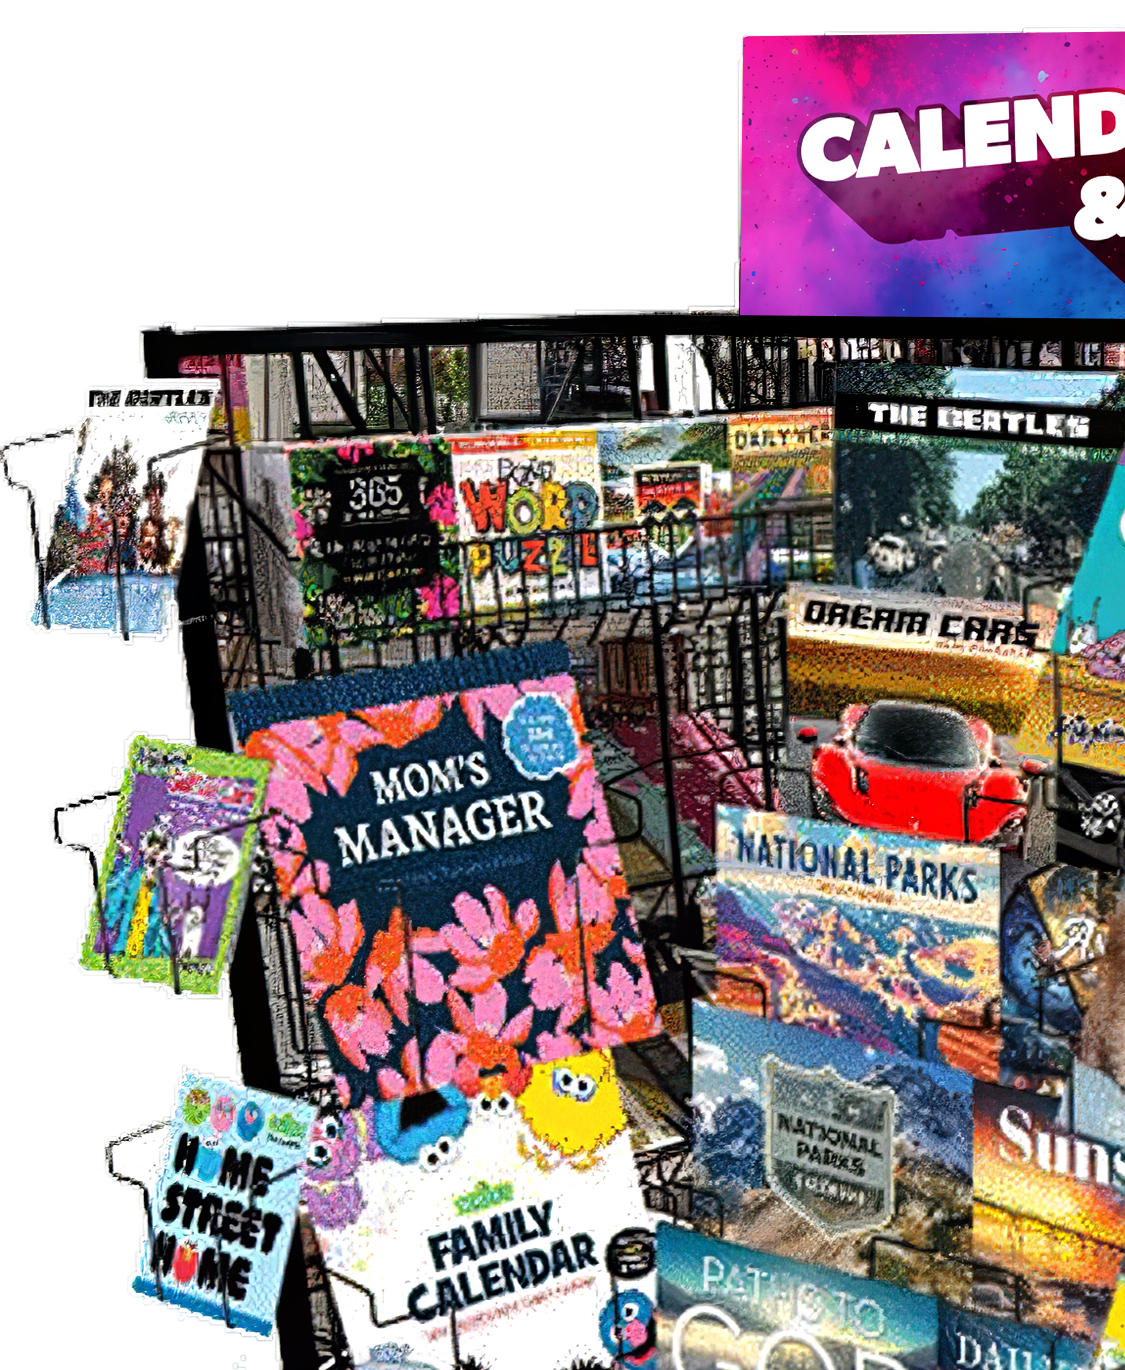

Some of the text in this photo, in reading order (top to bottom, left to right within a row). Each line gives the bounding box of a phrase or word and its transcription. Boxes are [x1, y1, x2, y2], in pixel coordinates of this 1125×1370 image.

[867, 401, 1091, 440] THE BEATLES
[459, 477, 600, 534] WORD
[803, 600, 931, 634] DREAM
[939, 614, 1040, 647] CARS
[369, 750, 492, 805] MOM'S
[333, 790, 553, 868] MANAGER
[735, 828, 979, 905] NATIONAL PARKS
[776, 1111, 883, 1159] NATIONAL
[159, 1181, 284, 1256] STREET
[427, 1199, 553, 1272] FAMILY
[406, 1231, 599, 1323] CALENDAR
